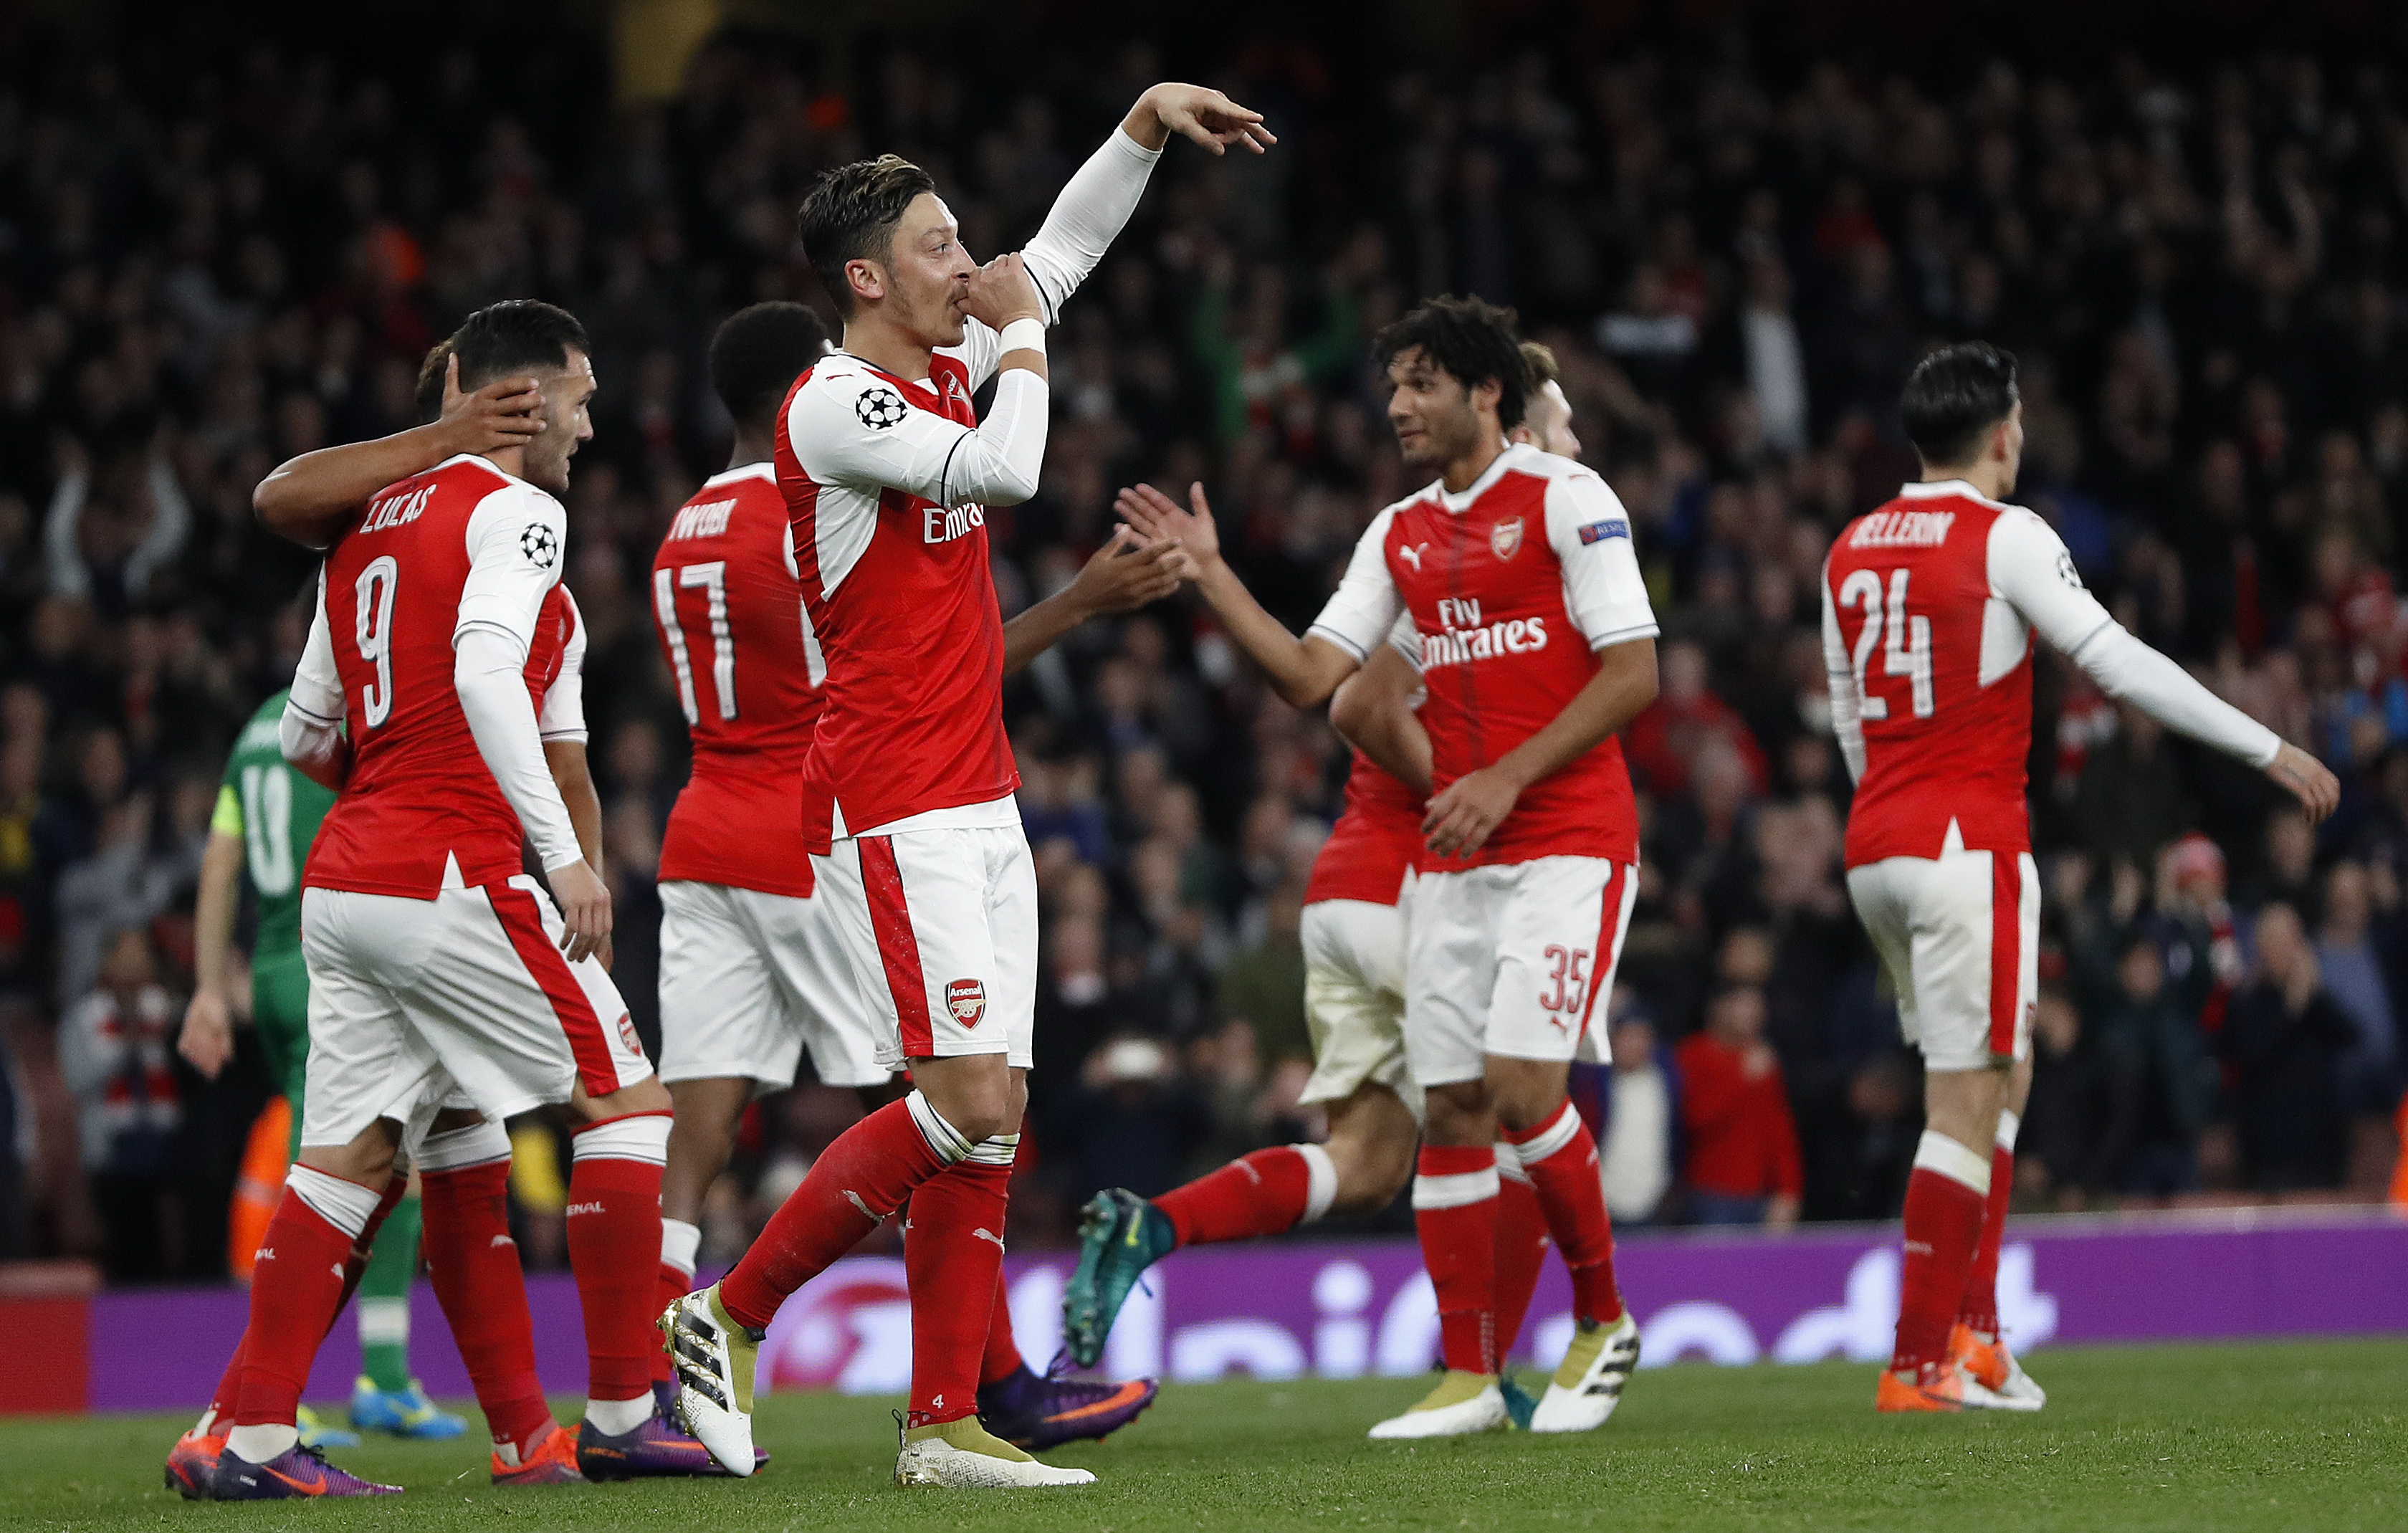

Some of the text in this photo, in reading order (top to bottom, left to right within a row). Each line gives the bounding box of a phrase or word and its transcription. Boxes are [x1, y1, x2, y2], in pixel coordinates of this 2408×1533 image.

[359, 484, 437, 534] LUCAS
[922, 502, 985, 543] Emira
[1438, 597, 1481, 627] Fly
[355, 555, 398, 730] 9
[654, 561, 739, 726] 17
[1838, 568, 1934, 719] 24
[950, 985, 981, 997] Arsenal
[1539, 943, 1589, 1014] 35
[932, 1394, 945, 1409] 4
